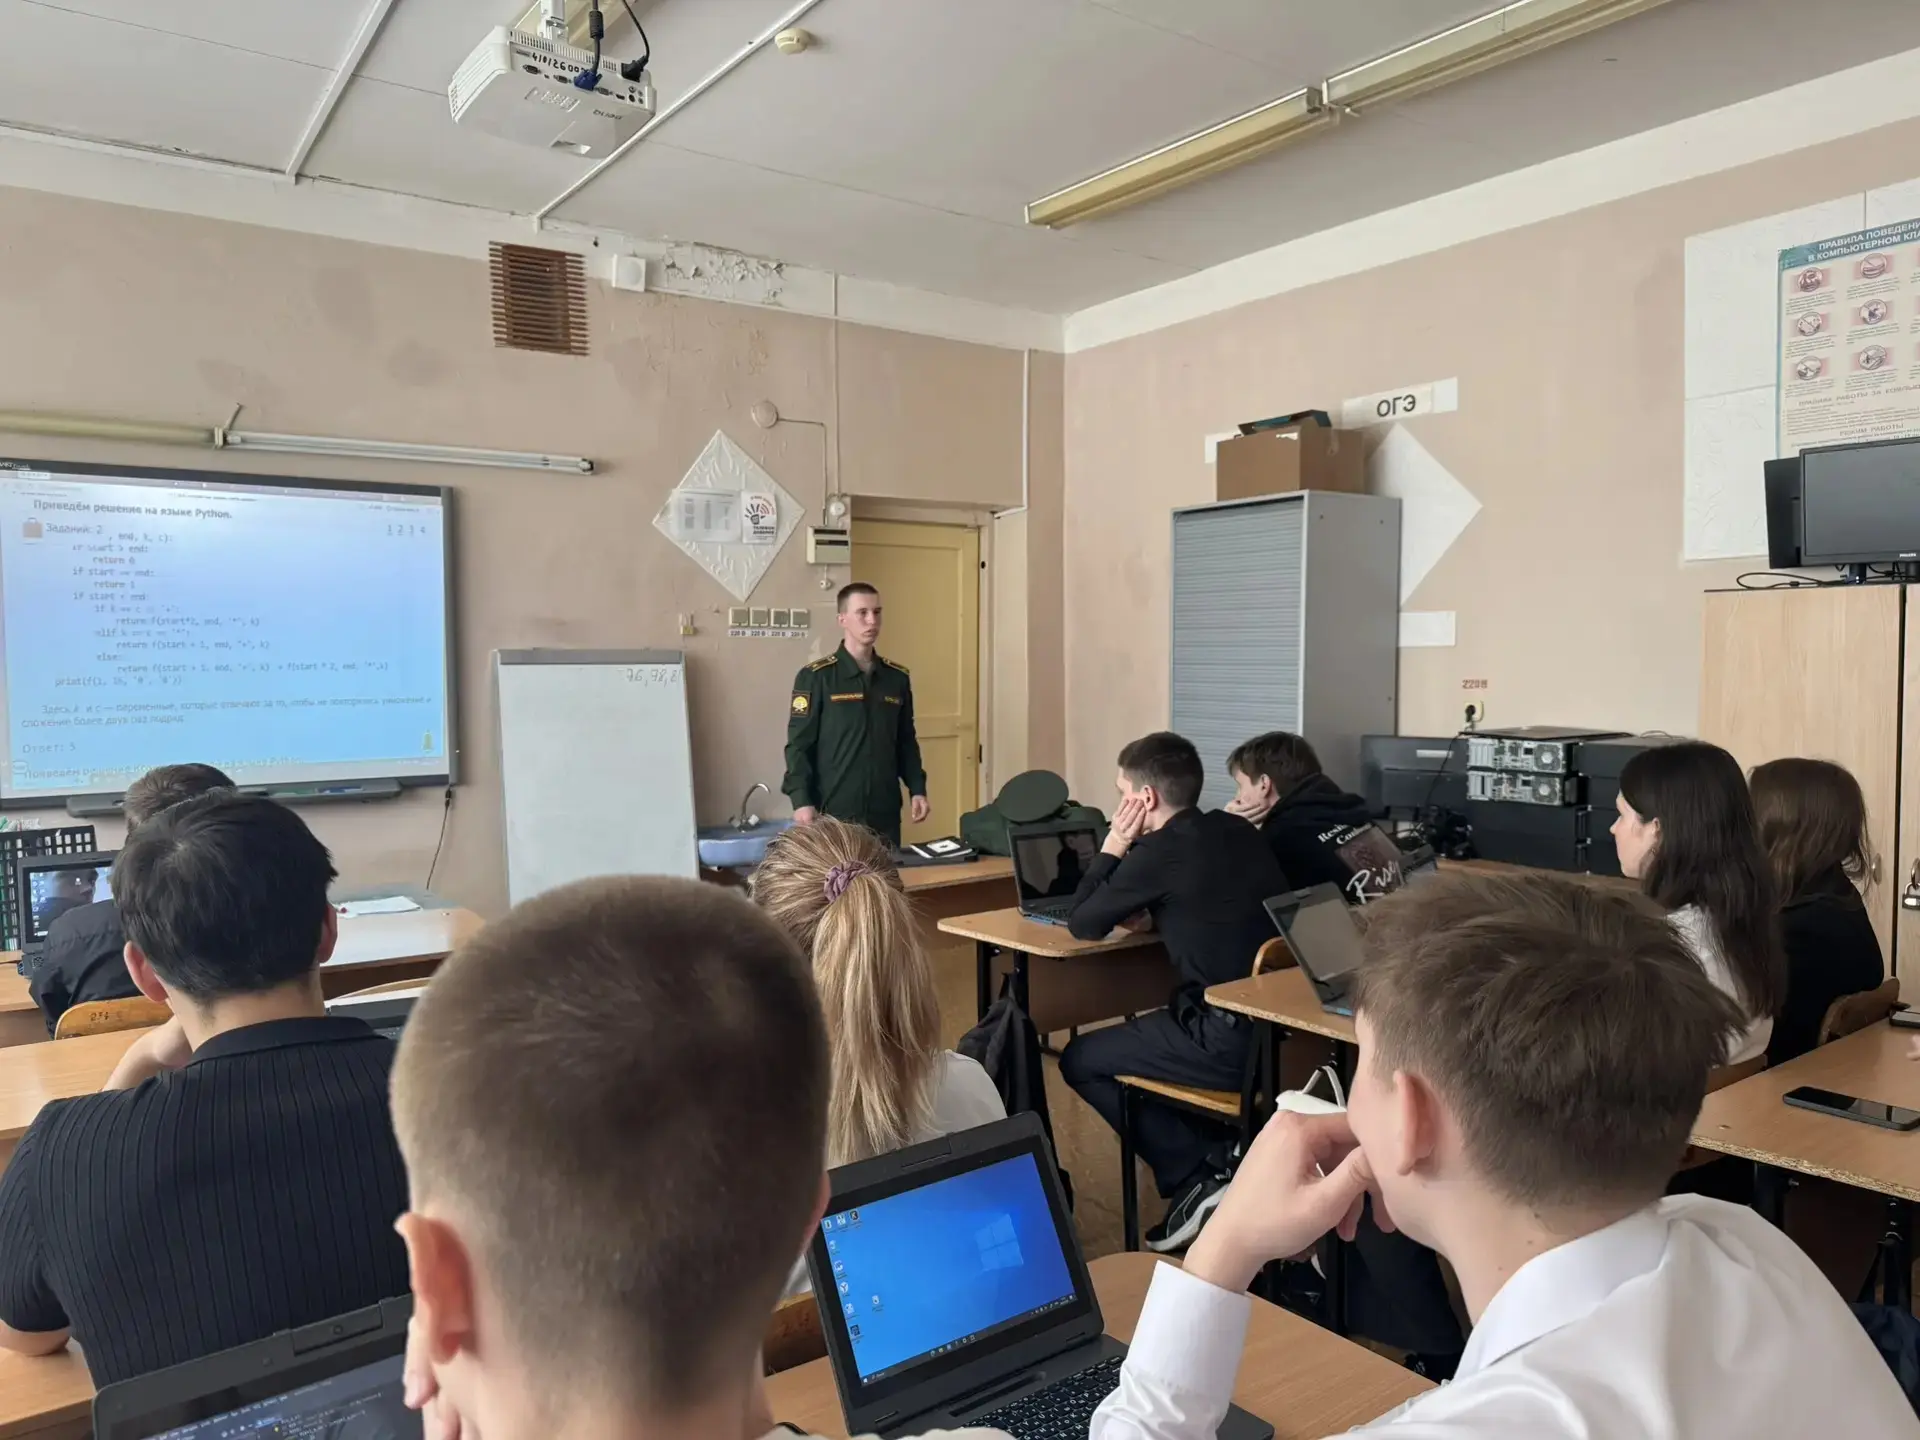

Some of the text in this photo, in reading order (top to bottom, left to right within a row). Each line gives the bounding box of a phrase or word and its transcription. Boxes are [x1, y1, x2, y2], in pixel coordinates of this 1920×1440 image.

[1808, 254, 1815, 262] В
[1816, 235, 1901, 261] КОМПЬЮТЕРНОМ
[1819, 234, 1864, 250] ПРАВИЛА
[1376, 394, 1417, 417] ОГЭ
[33, 499, 233, 519] Приведём решение на языке Python.
[22, 743, 64, 754] Ответ:
